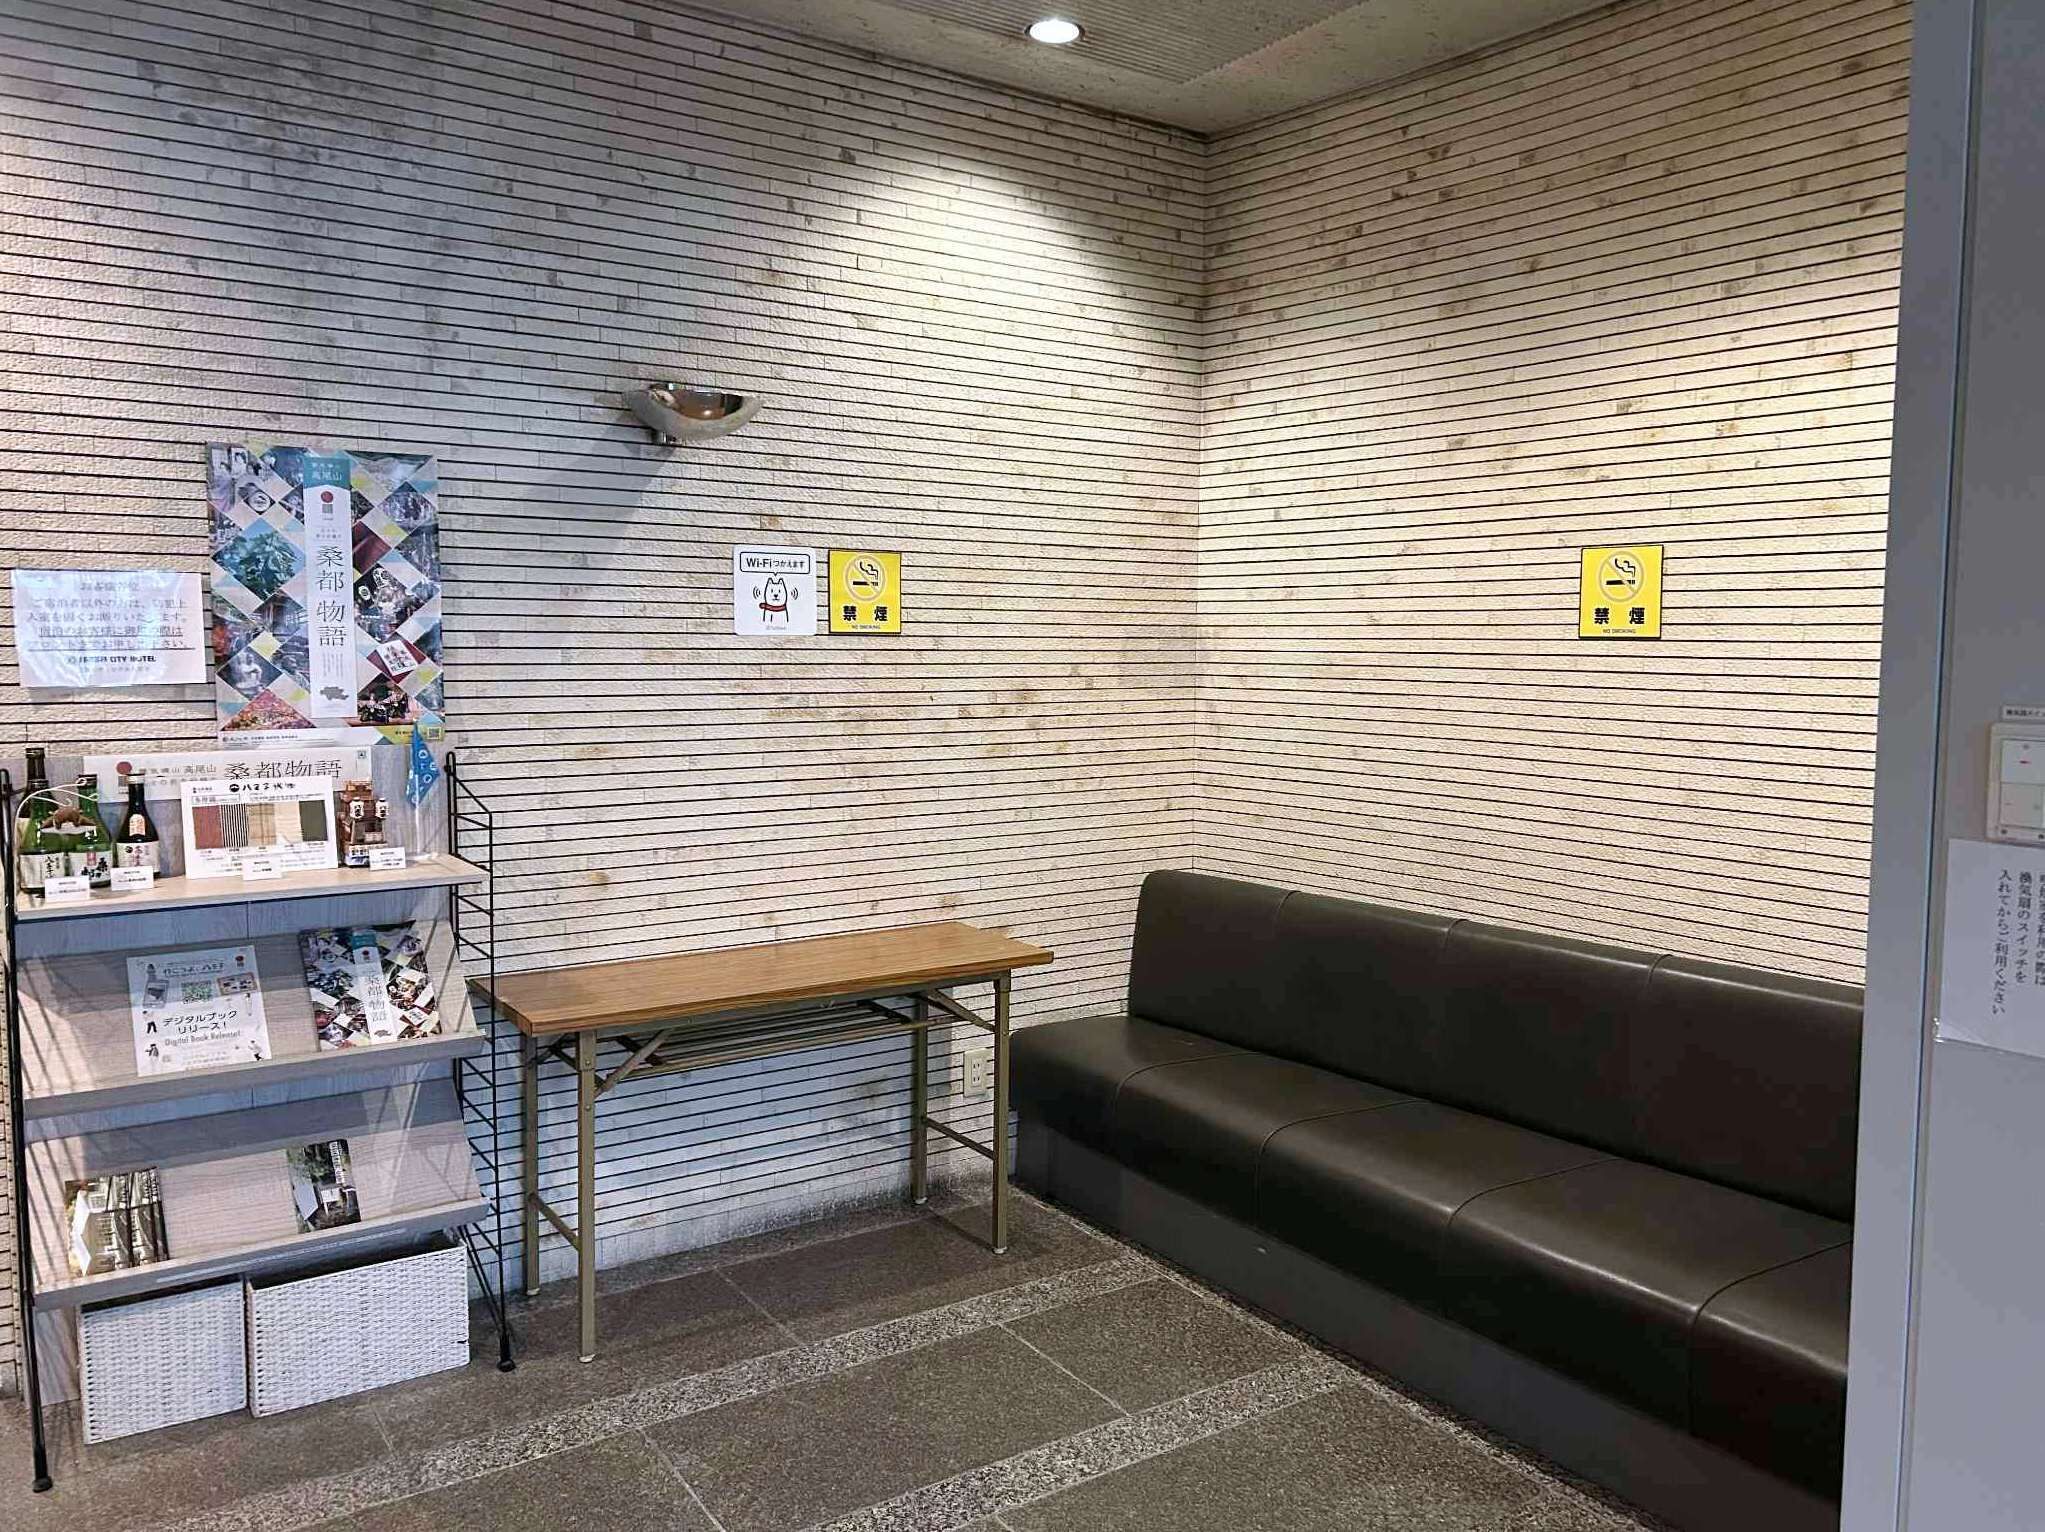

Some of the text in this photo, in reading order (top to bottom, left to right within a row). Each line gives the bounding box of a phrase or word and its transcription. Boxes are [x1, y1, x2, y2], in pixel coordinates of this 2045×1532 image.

[316, 545, 347, 648] 桑都物語
[225, 760, 343, 780] 桑都物語
[1992, 869, 2012, 1015] 入れてからご利用ください
[2015, 871, 2033, 984] 換気扇のスイッチを
[163, 1010, 238, 1027] デジタルブック
